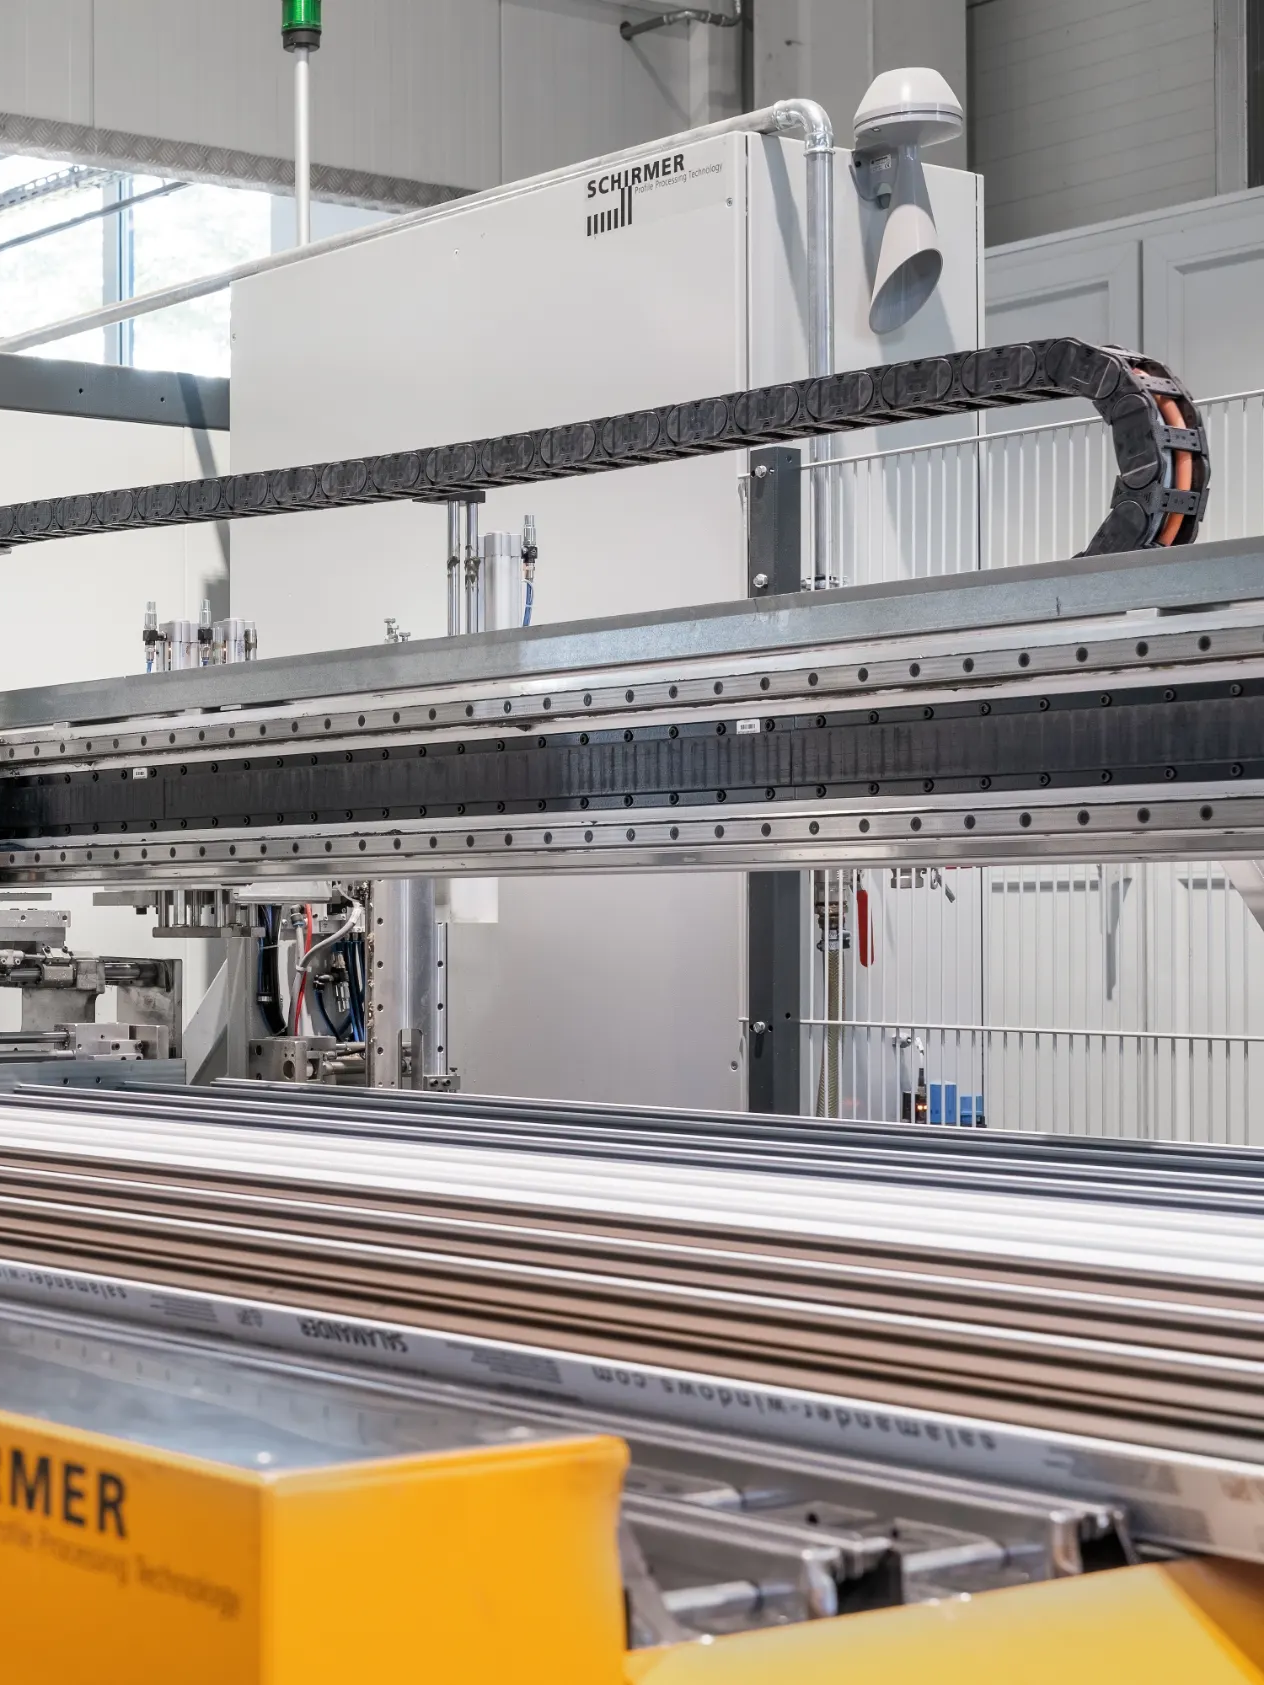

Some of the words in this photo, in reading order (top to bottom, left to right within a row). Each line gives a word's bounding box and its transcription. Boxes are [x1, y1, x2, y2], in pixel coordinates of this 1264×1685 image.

[587, 153, 685, 199] SCHIRMER
[634, 183, 654, 195] Profile
[656, 172, 687, 189] Processing
[688, 162, 724, 179] Technology
[297, 1316, 410, 1353] SALAMANDER
[591, 1365, 997, 1451] salamander-windows.com
